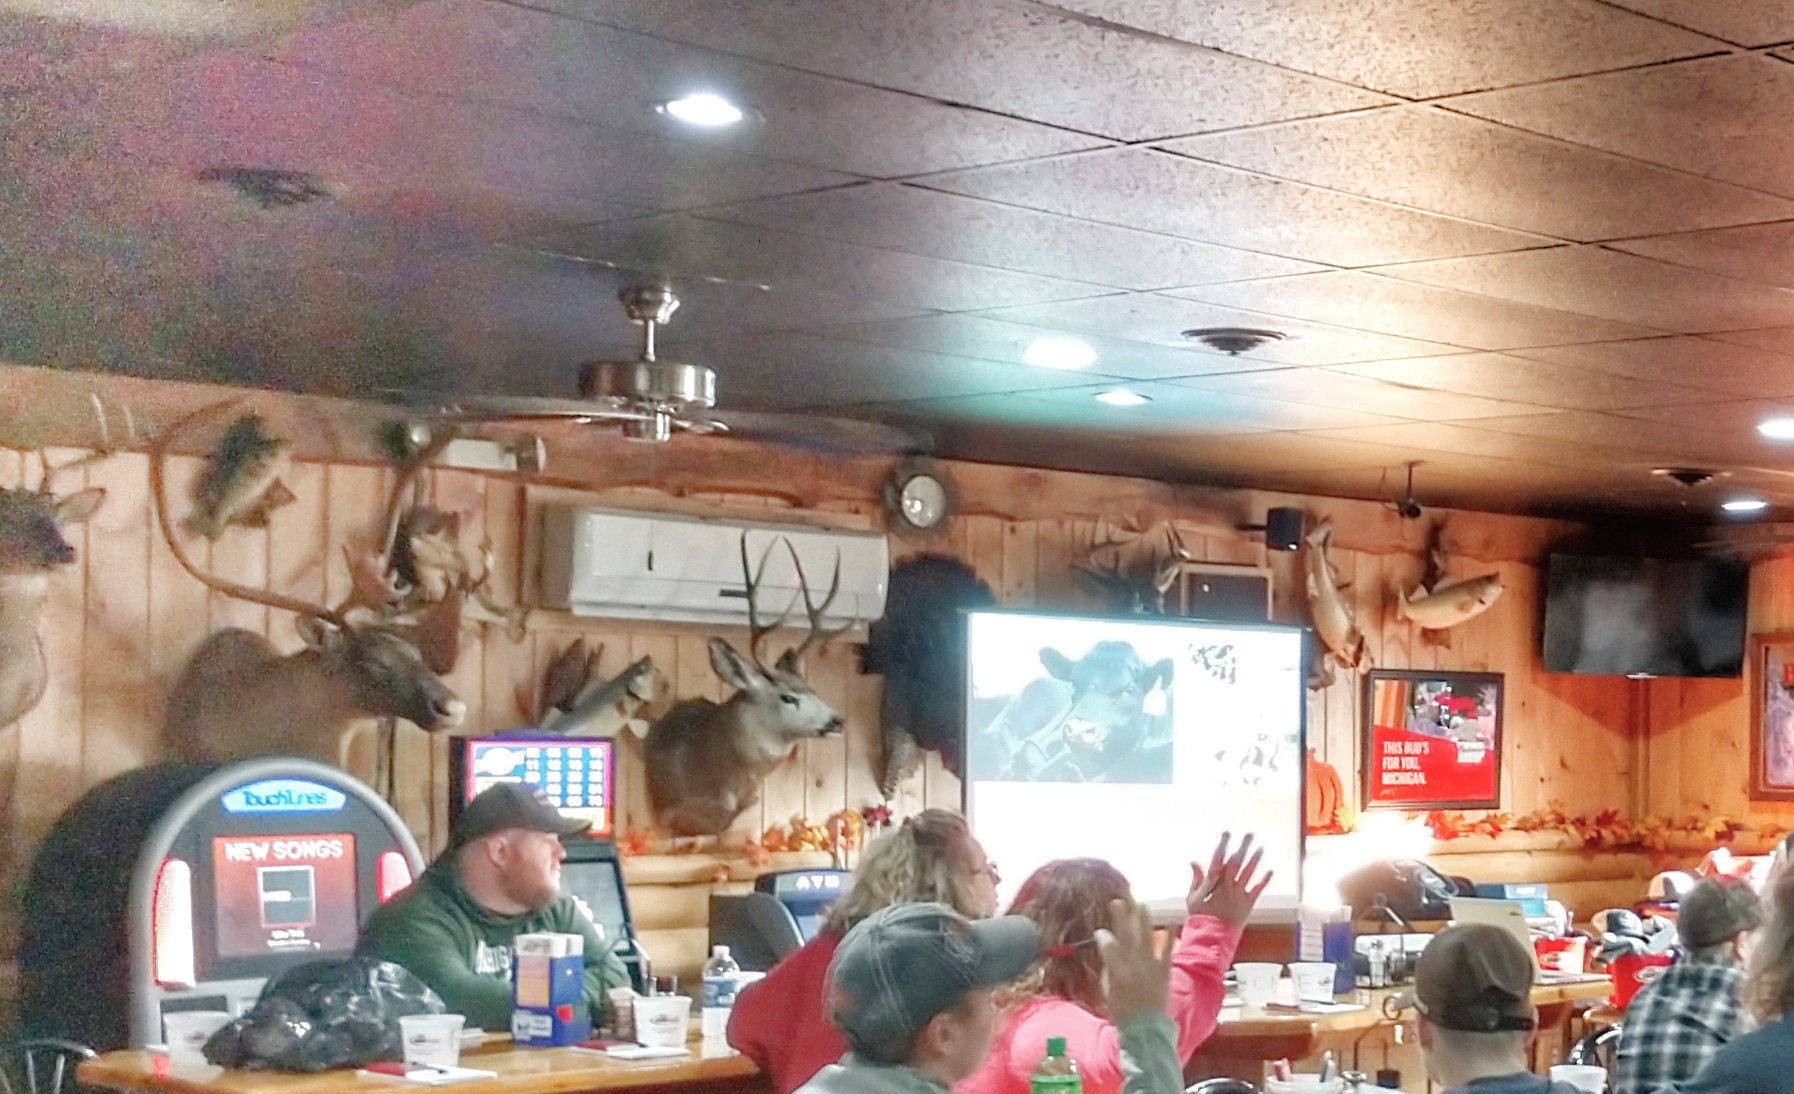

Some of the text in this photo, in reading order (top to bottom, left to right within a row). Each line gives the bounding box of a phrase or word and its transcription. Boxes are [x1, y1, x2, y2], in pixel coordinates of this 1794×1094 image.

[1383, 741, 1430, 754] THIS BUD'S
[1382, 757, 1400, 769] FOR
[225, 839, 343, 861] NEW SONGS
[795, 873, 840, 891] ATM
